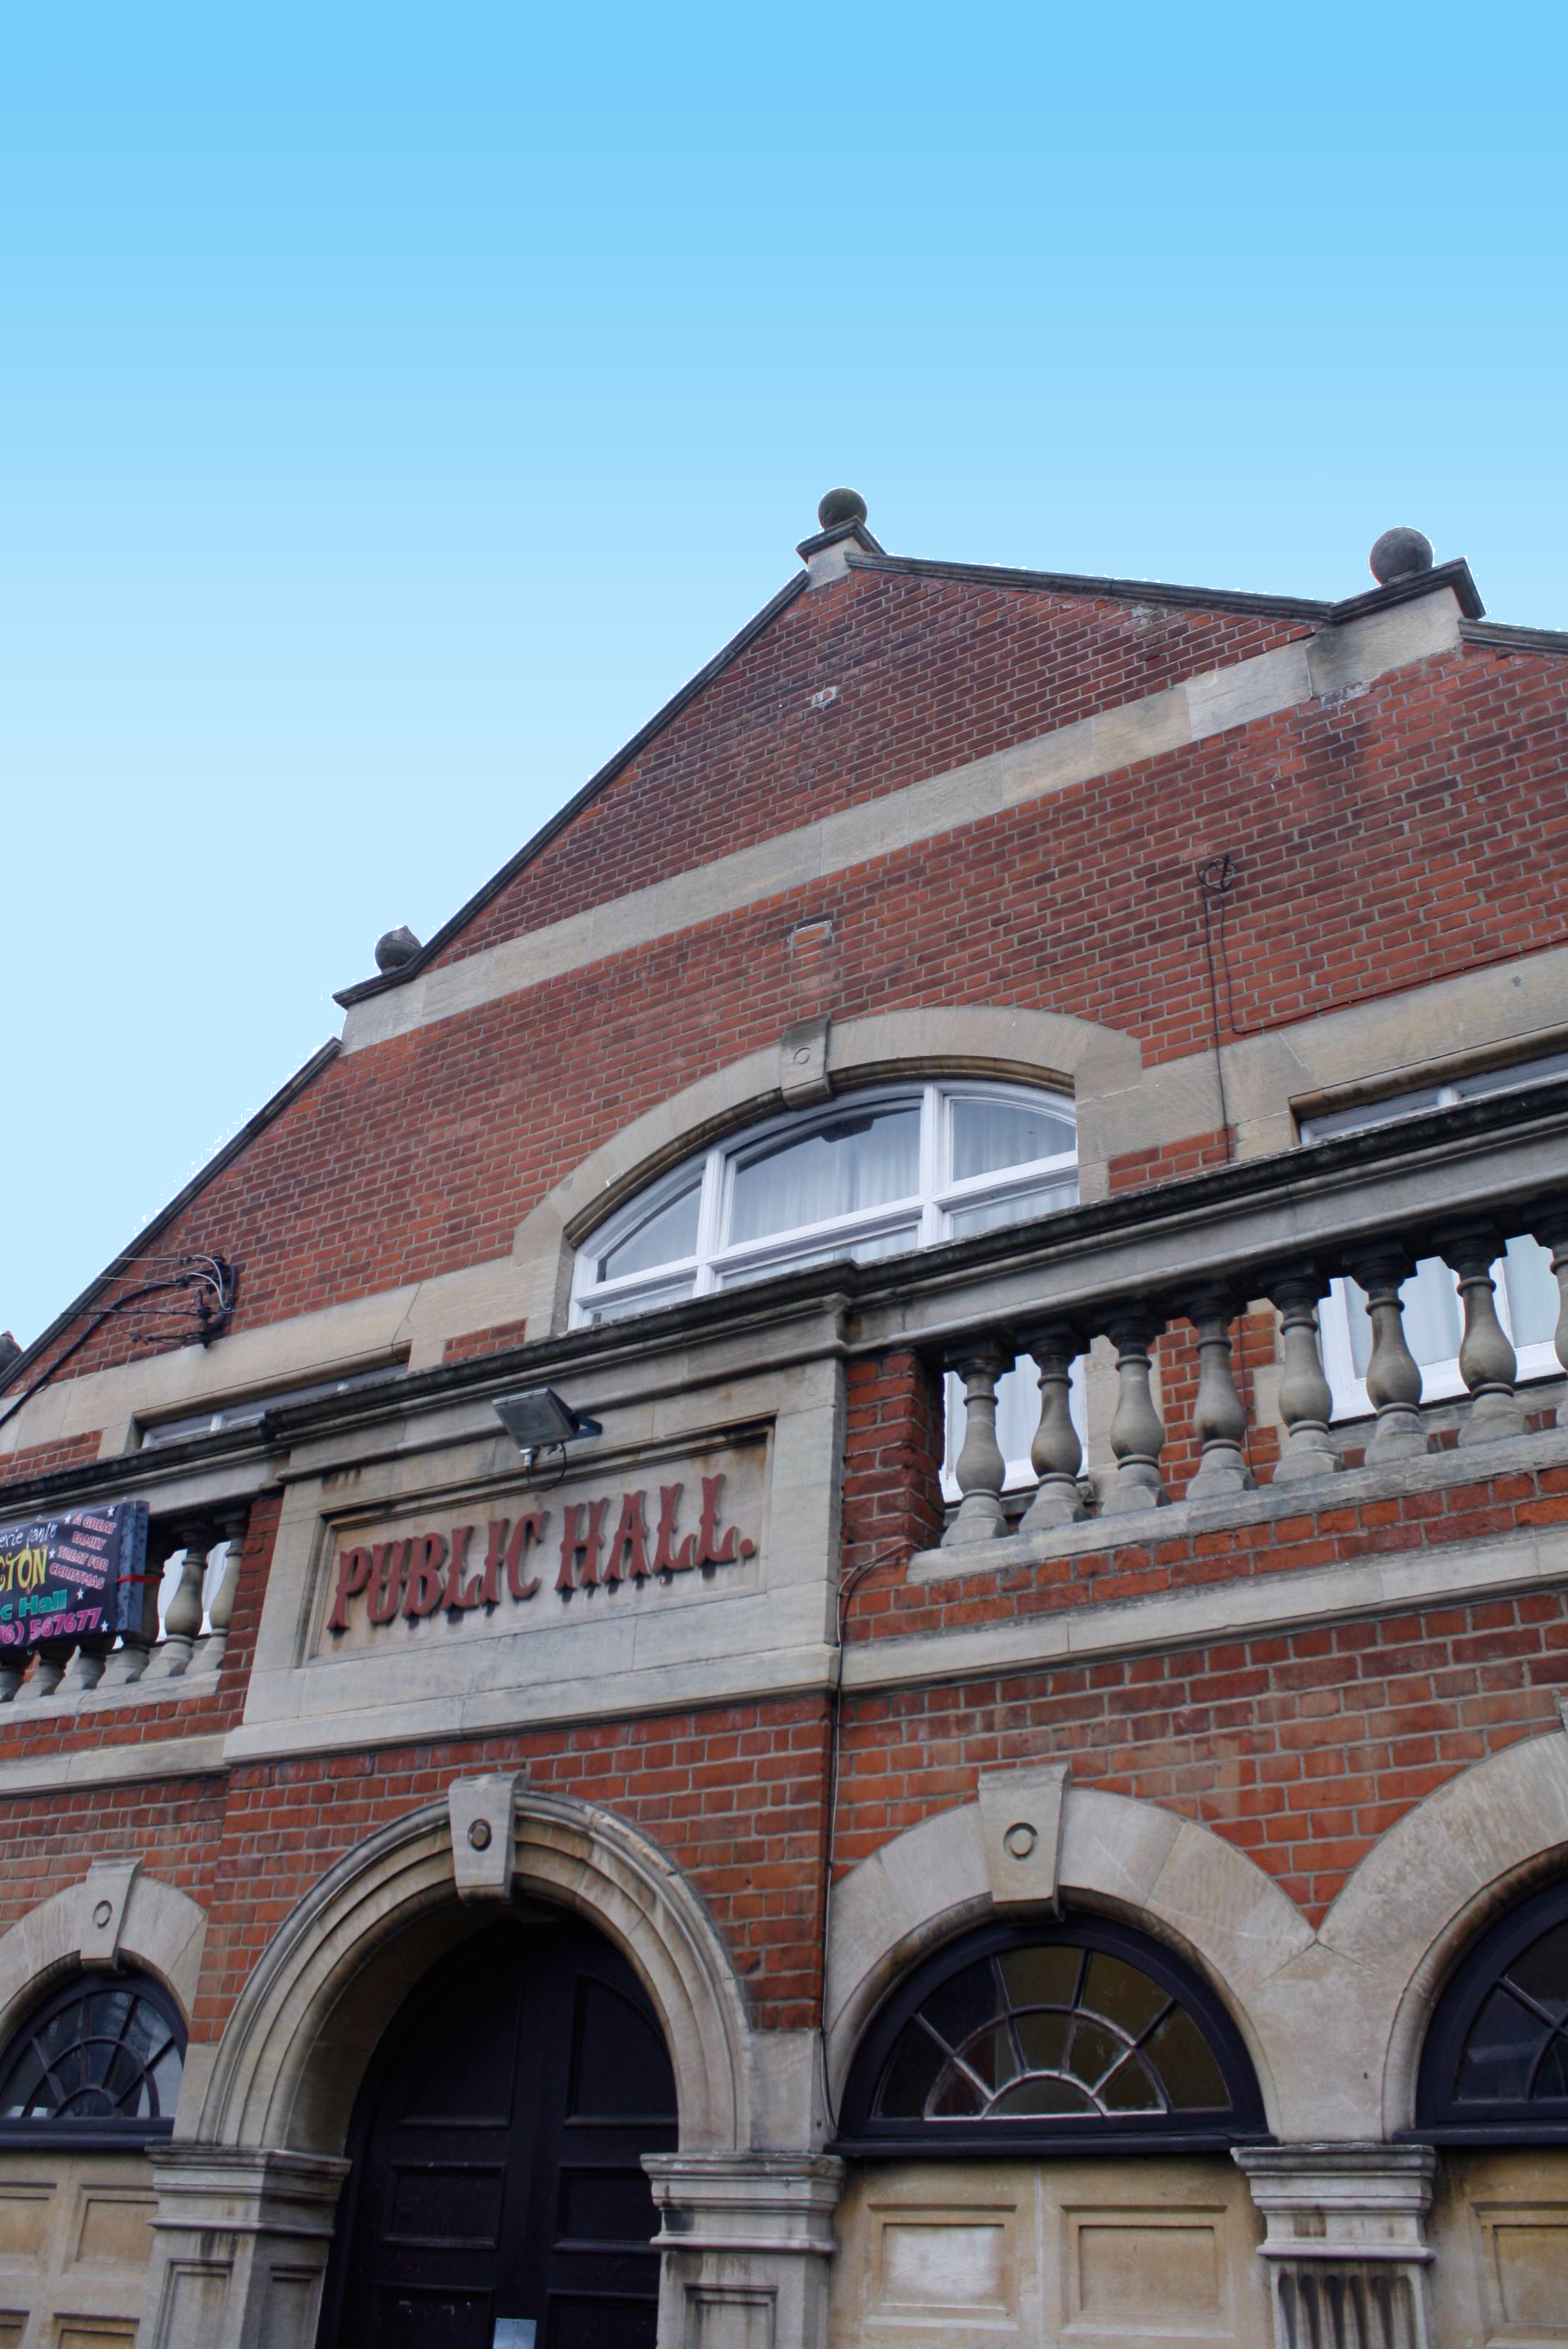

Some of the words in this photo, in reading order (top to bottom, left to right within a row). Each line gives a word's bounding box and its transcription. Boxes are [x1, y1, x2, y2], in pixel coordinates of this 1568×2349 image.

[73, 1513, 83, 1525] A
[83, 1516, 117, 1534] GREAT
[72, 1532, 107, 1551] FAMILY
[327, 1511, 550, 1631] PUBLIC
[555, 1473, 755, 1592] HALL.
[58, 1546, 89, 1566] TREAT
[88, 1556, 108, 1572] FOR
[49, 1562, 105, 1590] CHRISTMAS
[19, 1589, 68, 1617] Hall
[29, 1607, 102, 1640] 567677
